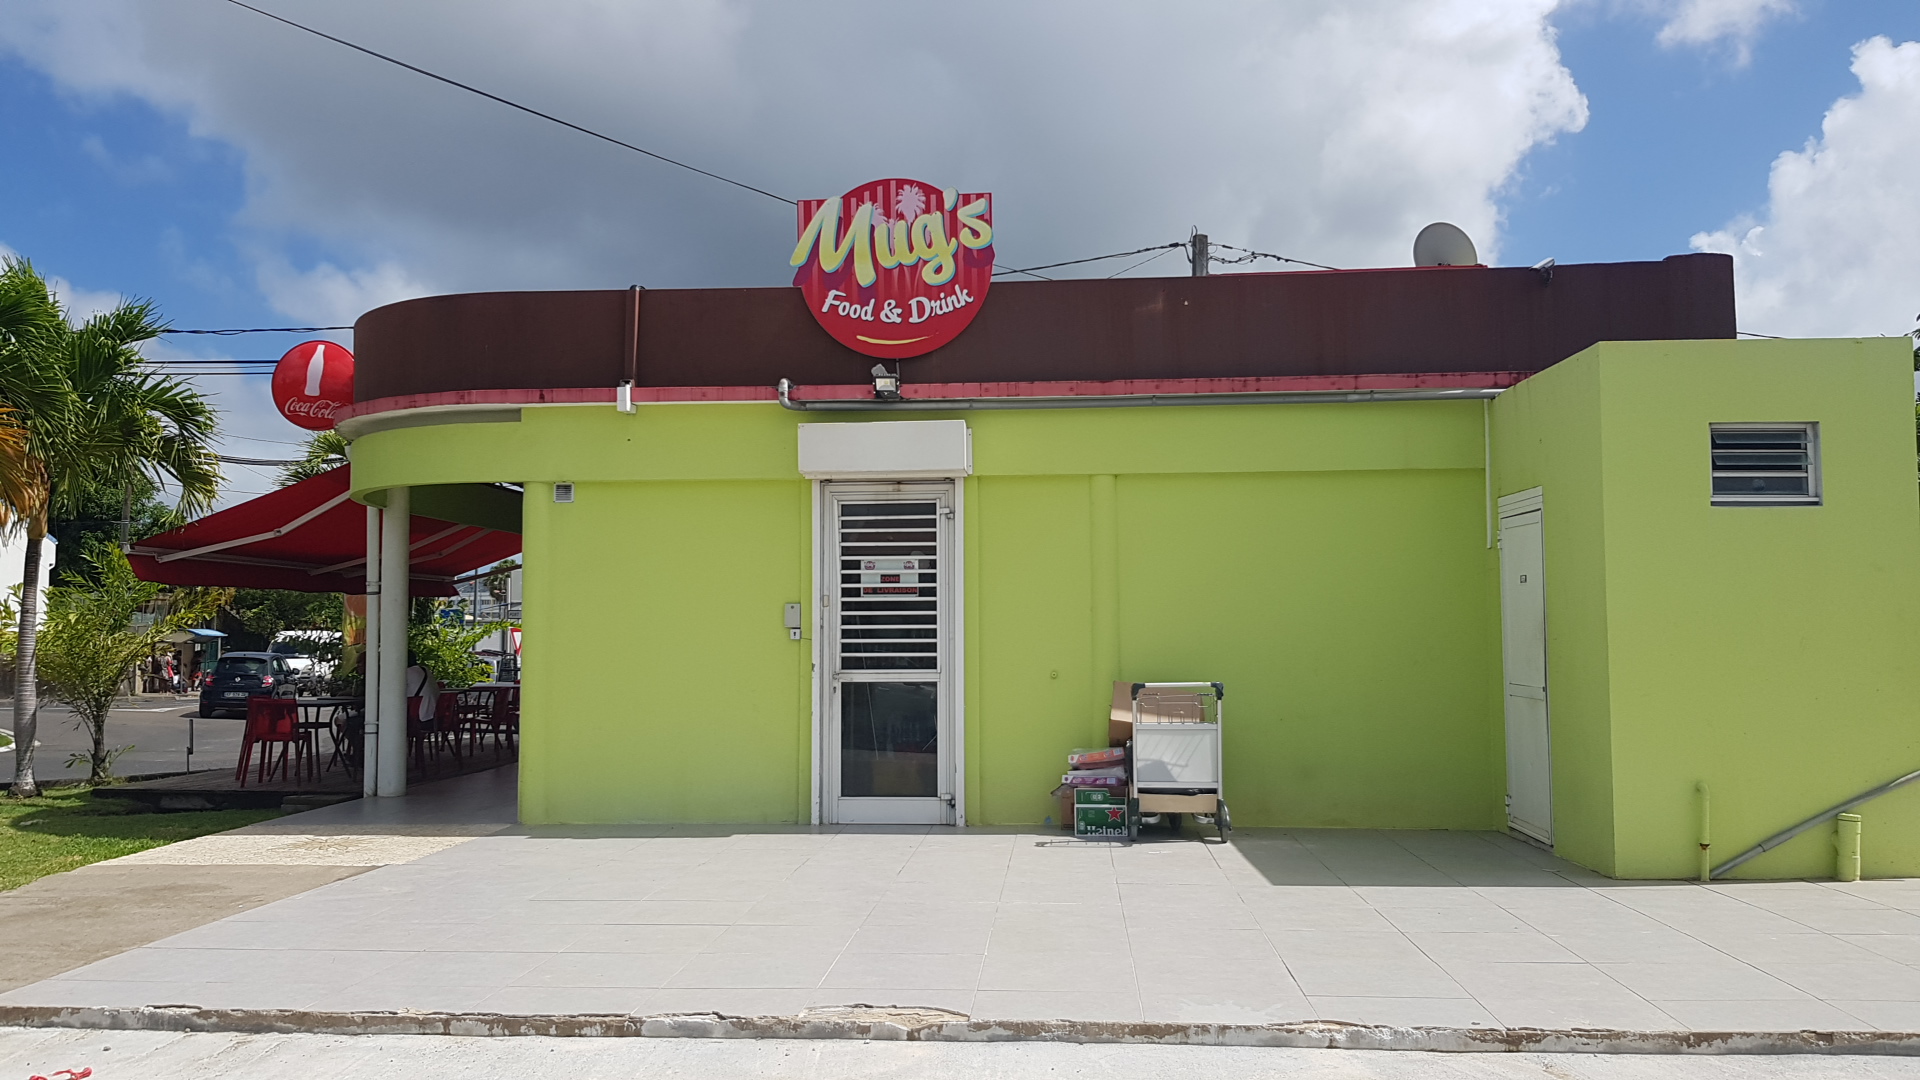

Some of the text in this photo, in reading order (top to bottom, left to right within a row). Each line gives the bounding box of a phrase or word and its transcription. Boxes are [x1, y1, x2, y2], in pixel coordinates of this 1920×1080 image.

[789, 186, 994, 288] Mug's
[821, 284, 974, 324] Food & Drink
